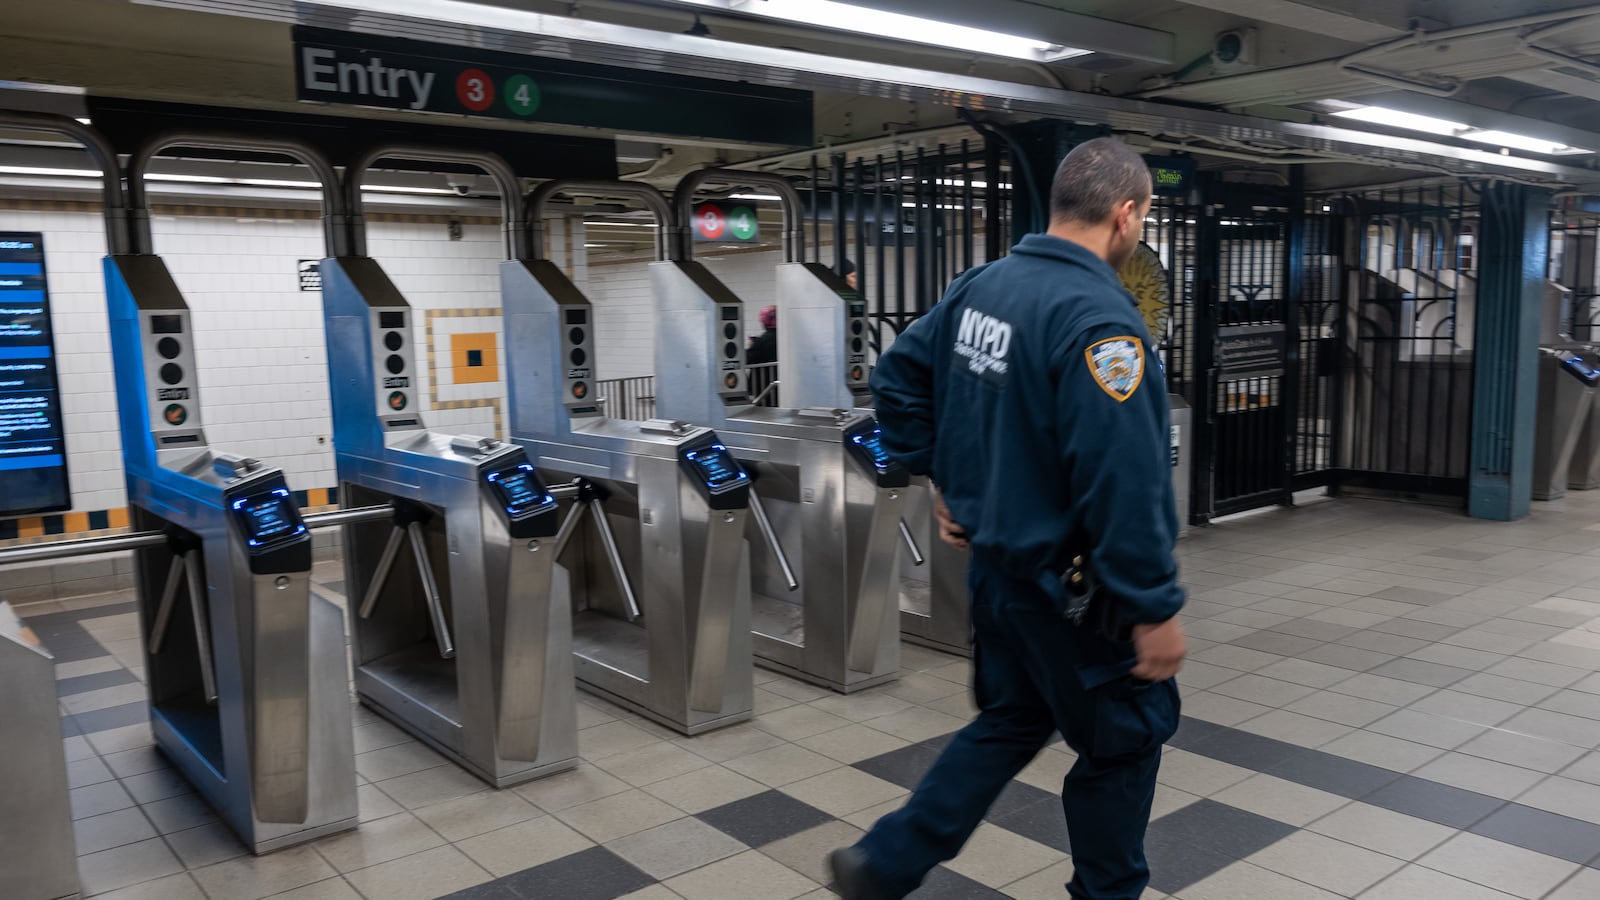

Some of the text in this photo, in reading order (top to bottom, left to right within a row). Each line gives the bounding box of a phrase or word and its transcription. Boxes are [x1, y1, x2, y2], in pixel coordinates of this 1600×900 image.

[302, 47, 530, 110] Entry 3 4
[703, 211, 750, 232] 3 4
[957, 307, 1012, 359] NYPD
